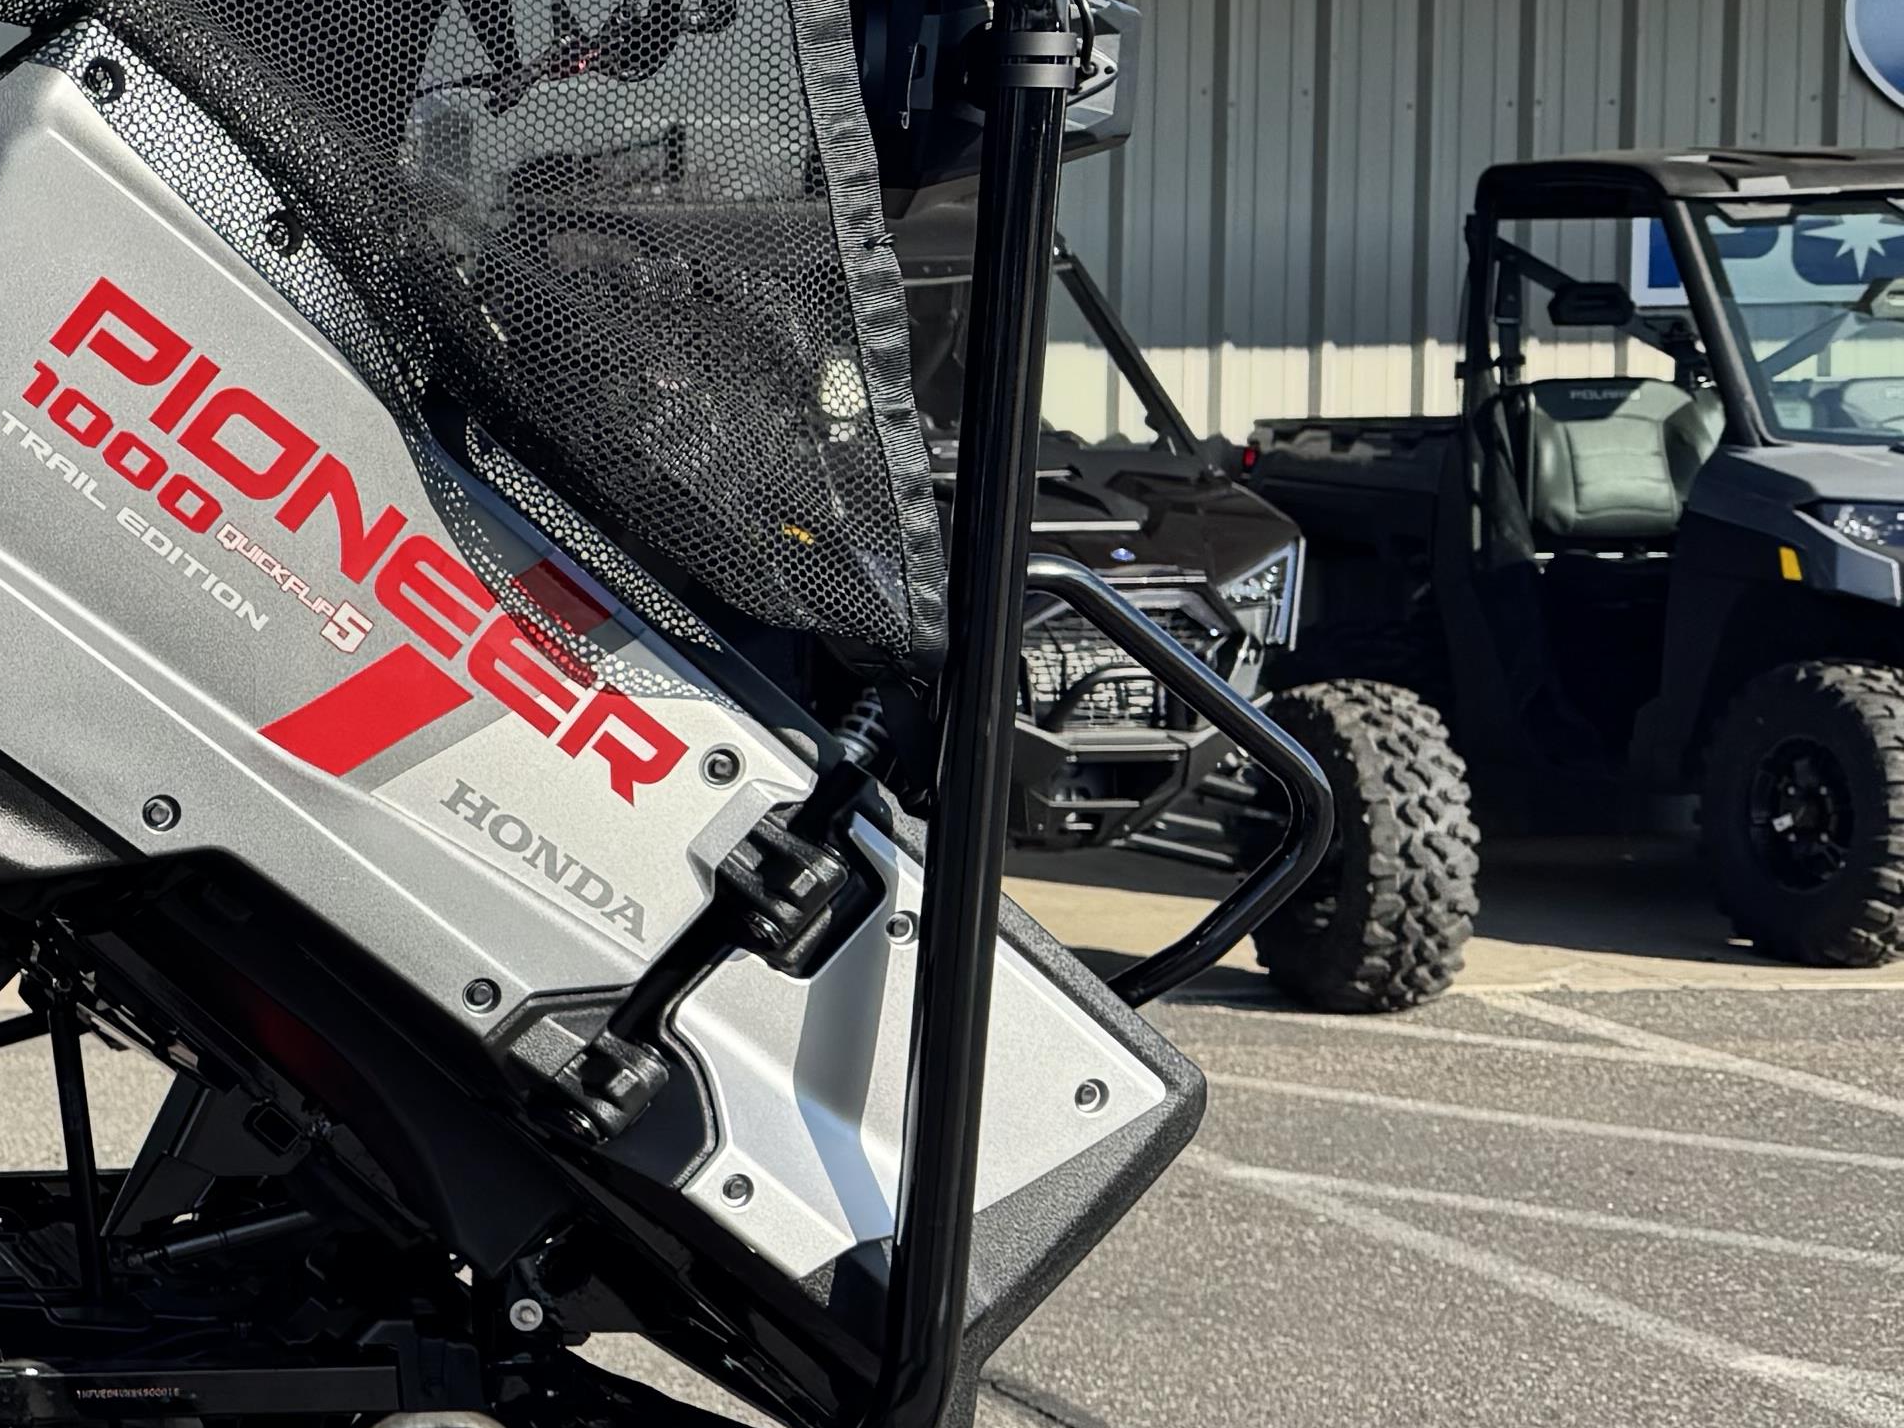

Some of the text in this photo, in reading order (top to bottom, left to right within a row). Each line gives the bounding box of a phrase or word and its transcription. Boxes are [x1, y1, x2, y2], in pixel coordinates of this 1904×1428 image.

[0, 411, 269, 633] TRAIL EDITION
[20, 359, 223, 536] 1000
[50, 276, 688, 805] PIONEER
[440, 778, 645, 942] HONDA
